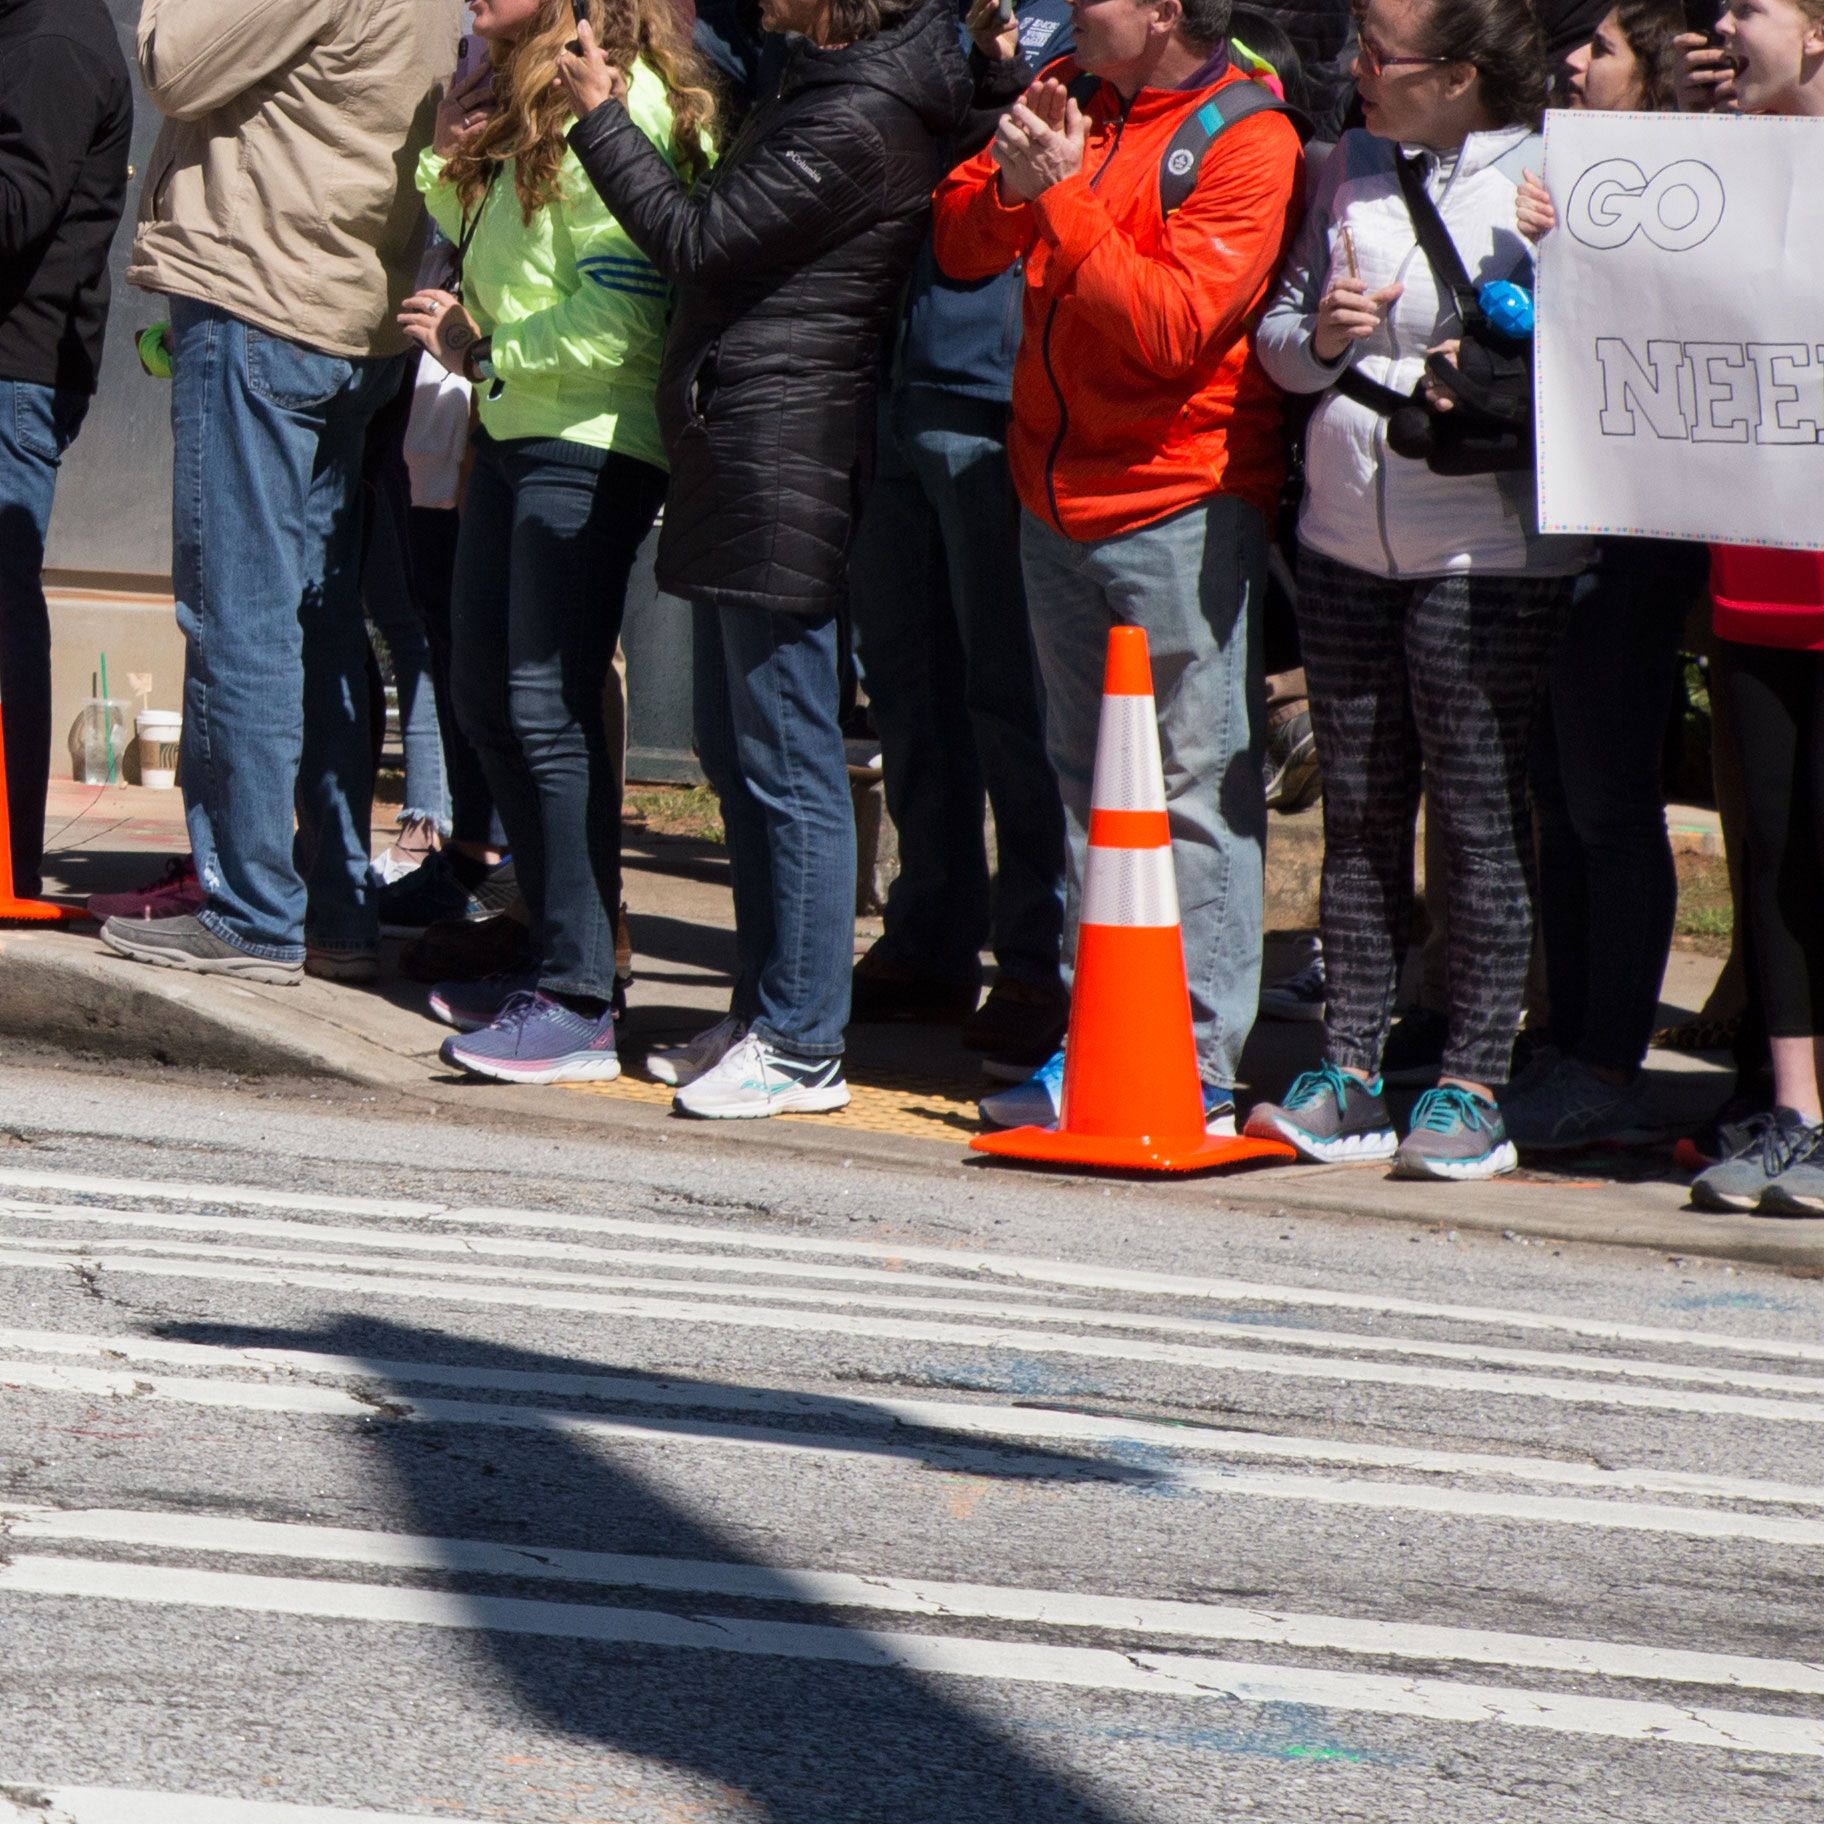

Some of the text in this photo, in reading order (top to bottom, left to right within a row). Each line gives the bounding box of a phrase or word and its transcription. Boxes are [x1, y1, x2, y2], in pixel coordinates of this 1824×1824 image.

[792, 153, 822, 184] Columbia
[1566, 157, 1726, 252] GO
[1596, 337, 1824, 445] NEE
